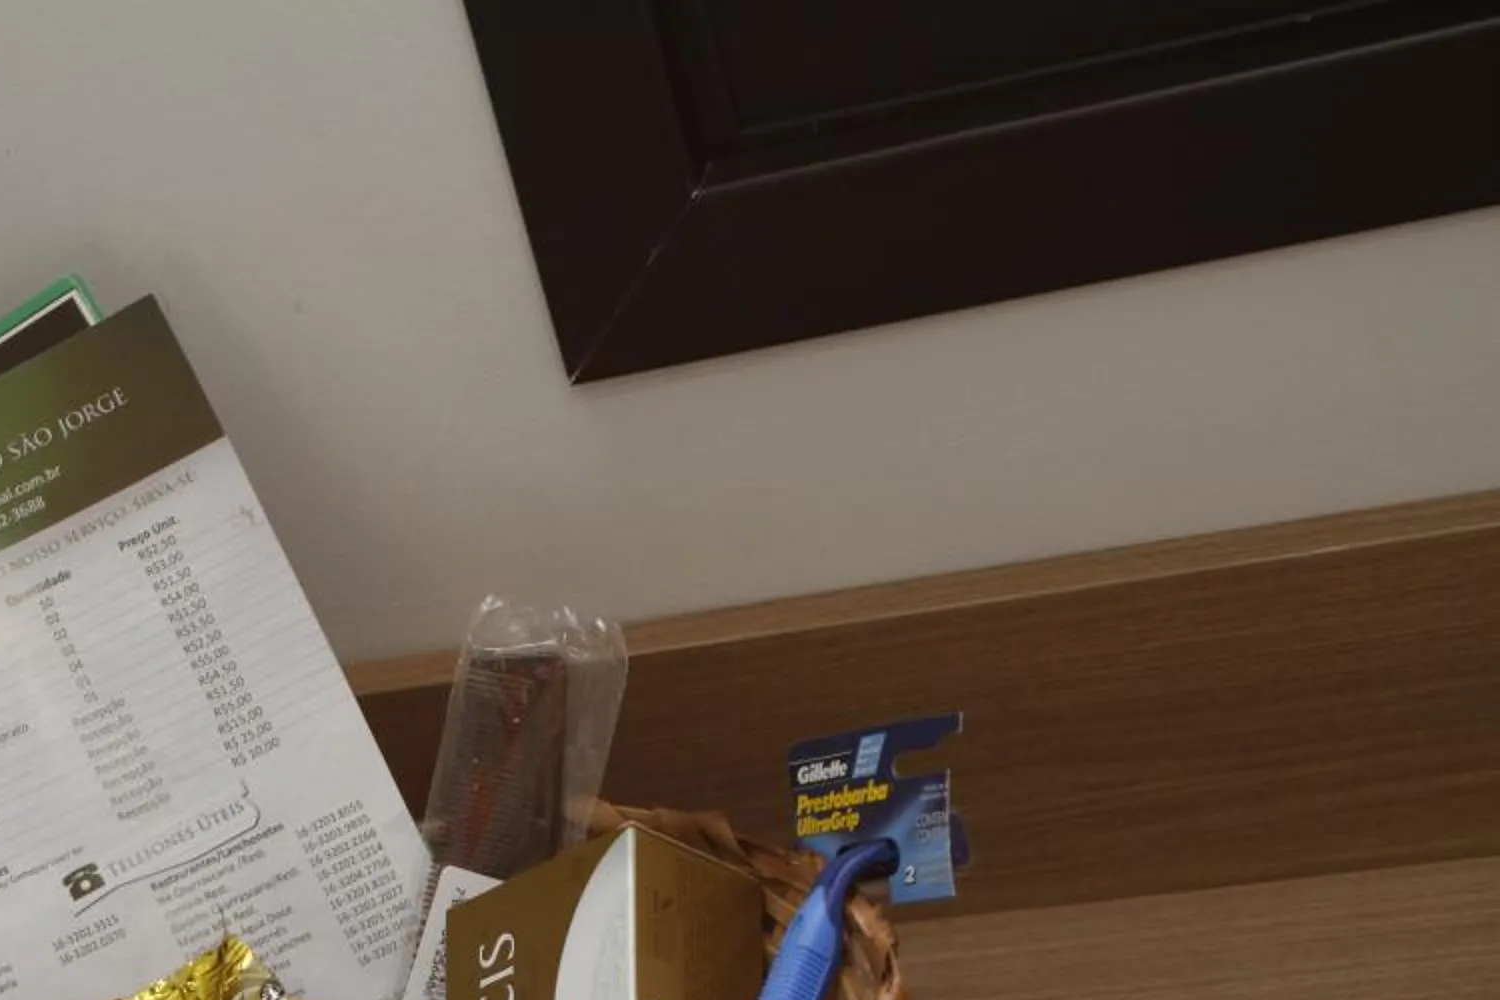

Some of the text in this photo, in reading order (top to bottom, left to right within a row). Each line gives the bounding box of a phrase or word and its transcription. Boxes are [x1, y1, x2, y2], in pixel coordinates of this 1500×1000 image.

[2, 419, 56, 462] SÃO
[52, 383, 133, 440] JORGE
[114, 525, 154, 554] Preço
[797, 760, 849, 785] Gillette
[796, 780, 890, 817] Prestobarba
[796, 810, 861, 837] UltraGrip
[903, 865, 917, 885] 2
